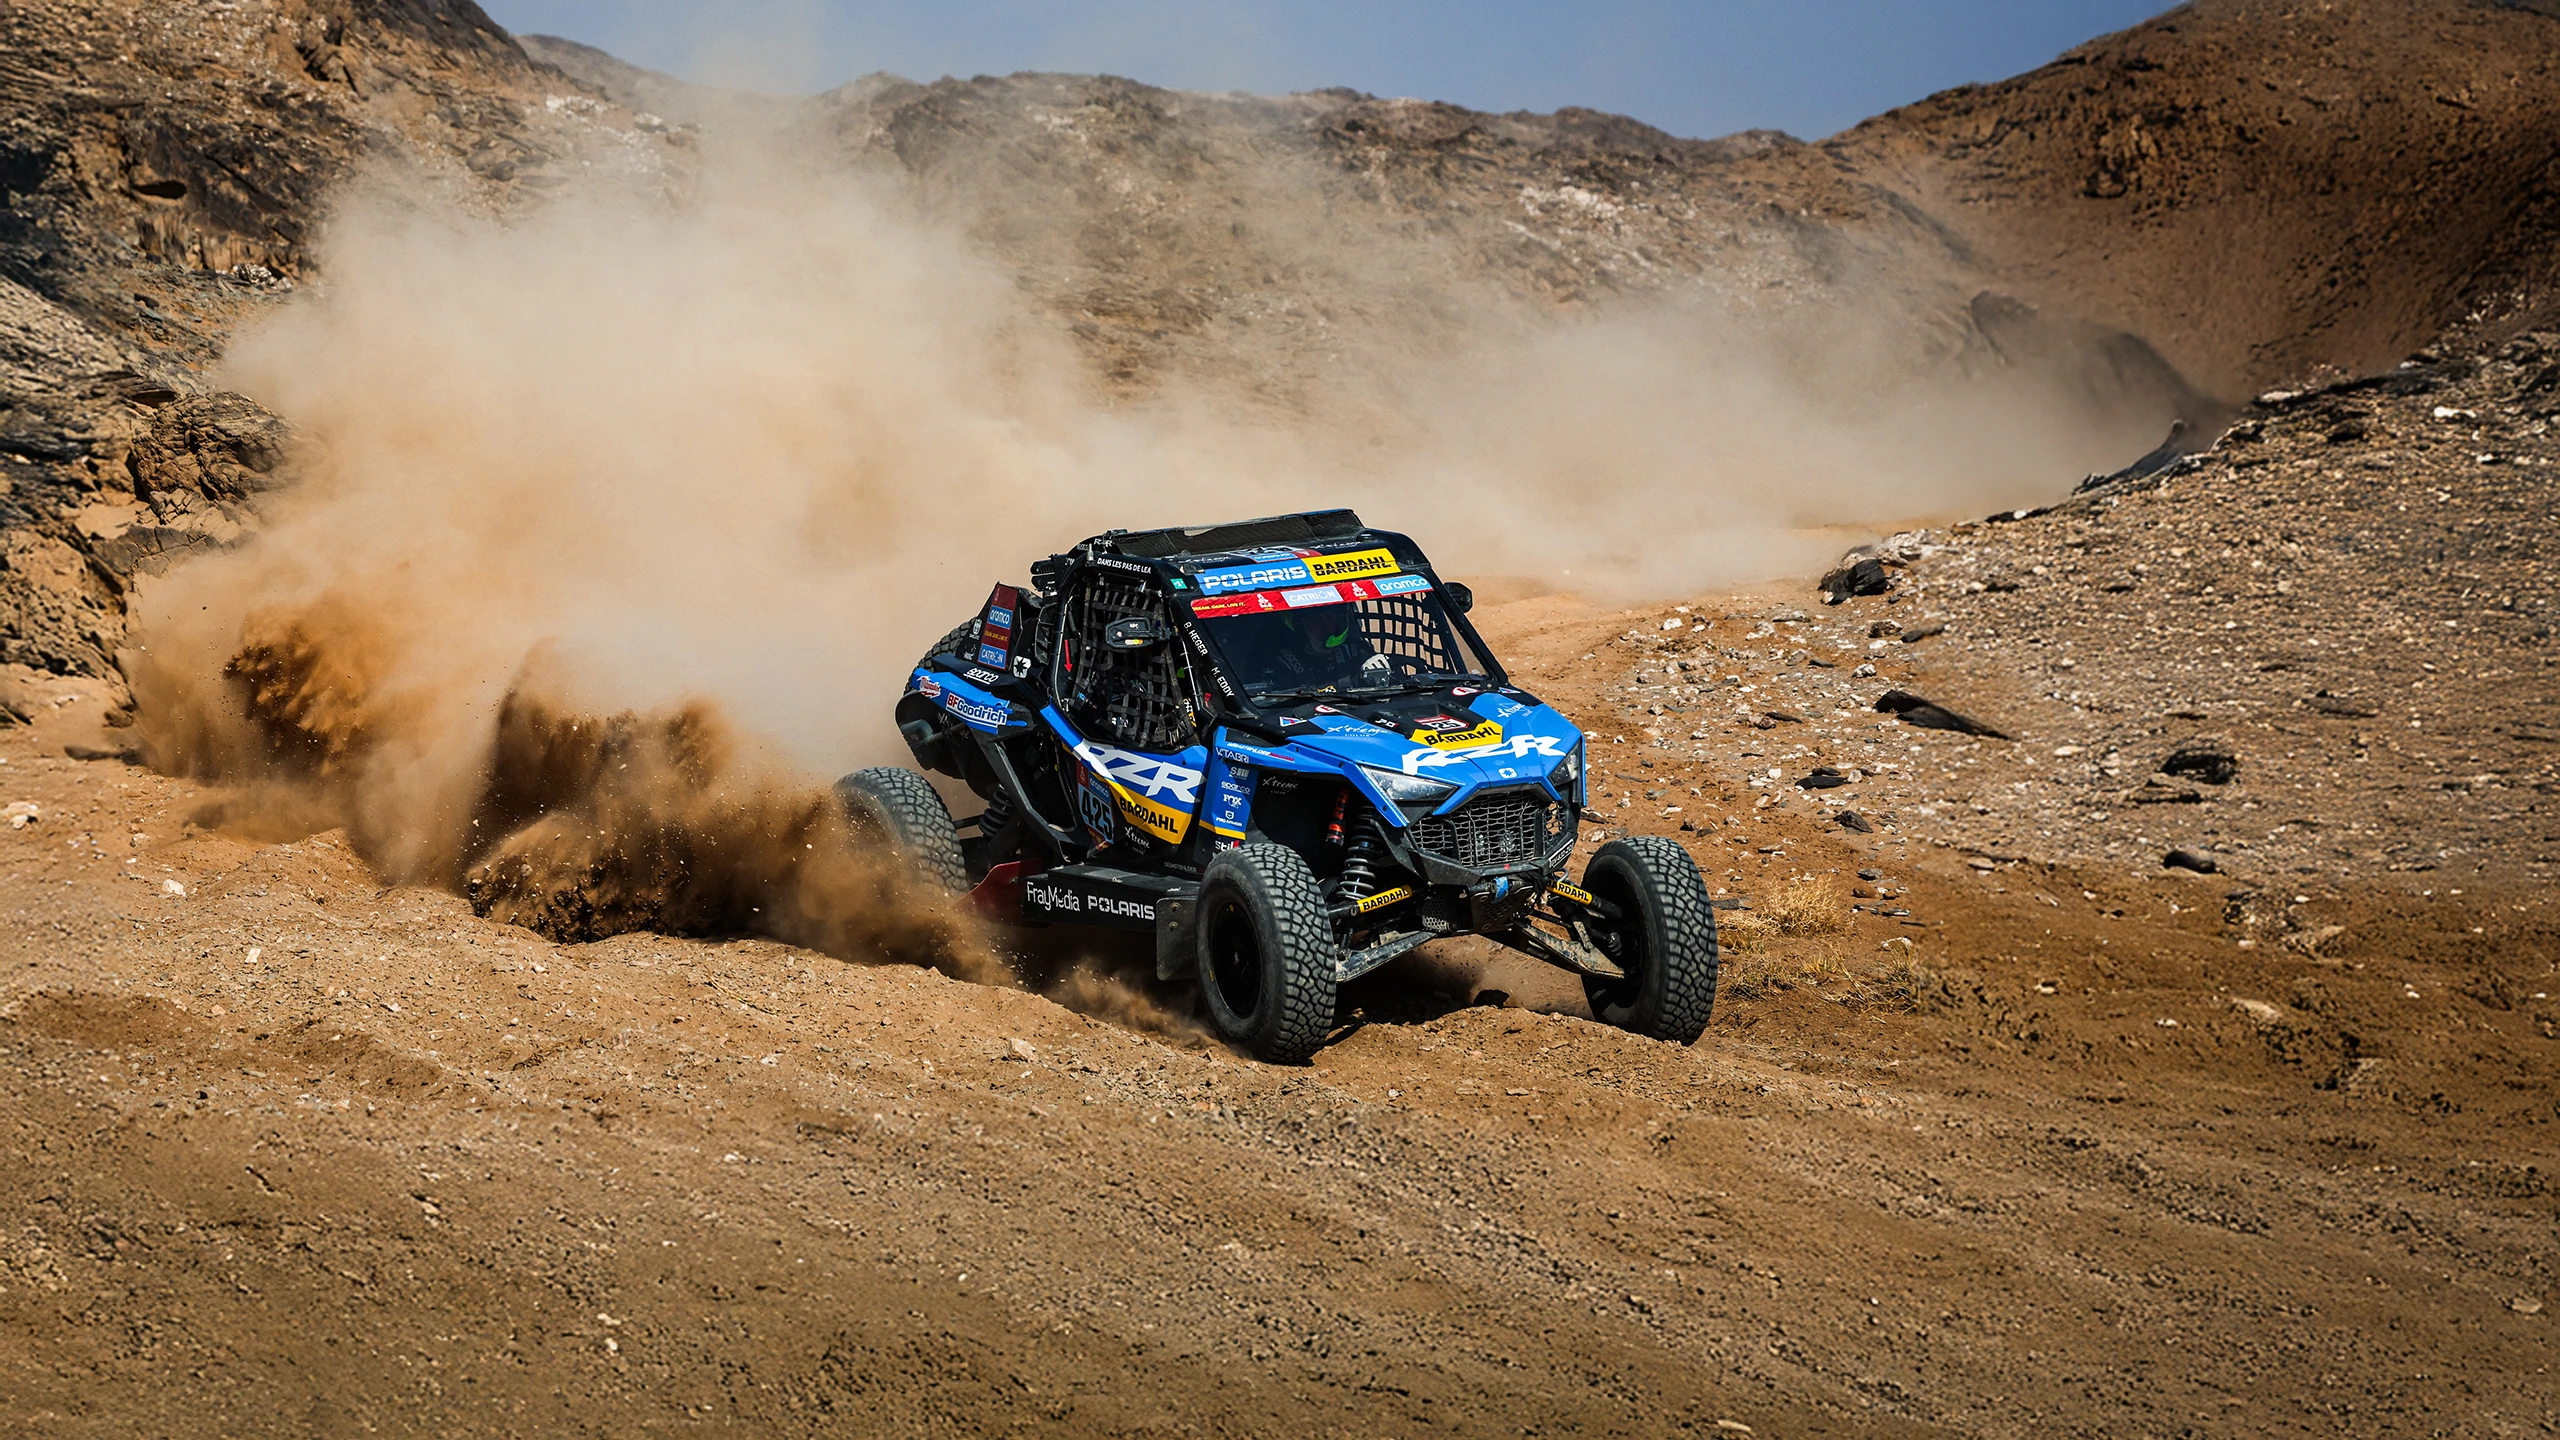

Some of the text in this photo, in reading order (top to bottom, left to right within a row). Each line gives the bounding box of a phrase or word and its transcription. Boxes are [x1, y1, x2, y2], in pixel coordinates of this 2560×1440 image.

[1097, 557, 1152, 574] DANS LES PAS DE LEA
[1312, 555, 1392, 577] BARDAHL
[1203, 566, 1307, 590] POLARIS
[1379, 578, 1429, 592] aramco
[990, 610, 1010, 625] aramco
[1183, 621, 1209, 656] B. HEGER
[966, 667, 999, 683] sparco
[1211, 666, 1235, 697] M. EDDY
[947, 694, 1007, 723] BFGoodrich
[1424, 726, 1501, 746] BARDAHL
[1402, 734, 1567, 775] RZR
[1073, 738, 1204, 804] RZR
[1220, 781, 1250, 794] sparco
[1223, 794, 1242, 807] FOX
[1081, 788, 1114, 840] 425
[1120, 799, 1178, 834] BARDAHL
[1026, 881, 1155, 920] FrayMédia POLARIS
[1362, 888, 1410, 911] BARDAHL
